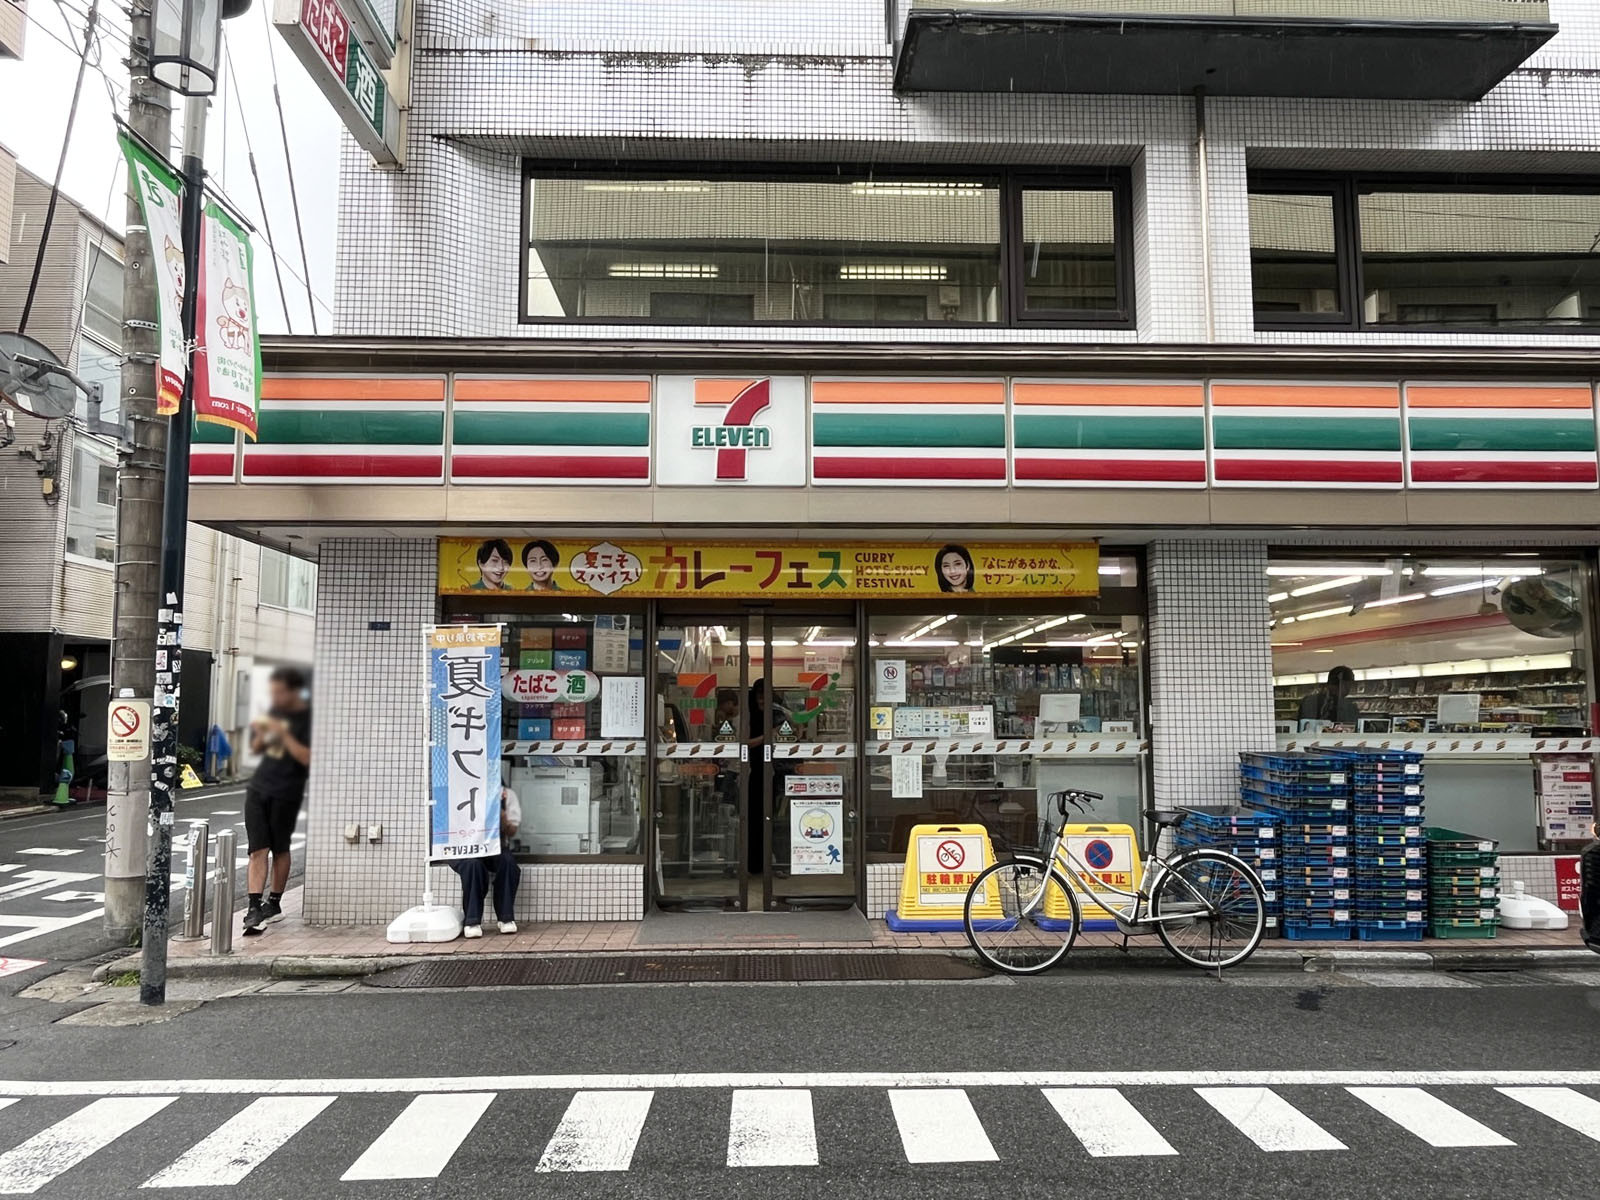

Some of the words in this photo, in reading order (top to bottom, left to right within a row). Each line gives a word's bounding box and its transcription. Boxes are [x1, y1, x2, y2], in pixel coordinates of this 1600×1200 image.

[354, 46, 378, 122] 酒
[584, 551, 629, 569] 夏こそ
[855, 552, 895, 563] CURRY
[649, 545, 847, 590] カレーフェス
[856, 578, 916, 589] FESTIVAL
[726, 655, 740, 666] AT
[513, 674, 558, 694] たばこ
[566, 674, 586, 694] 酒
[926, 873, 976, 885] 駐輪禁止
